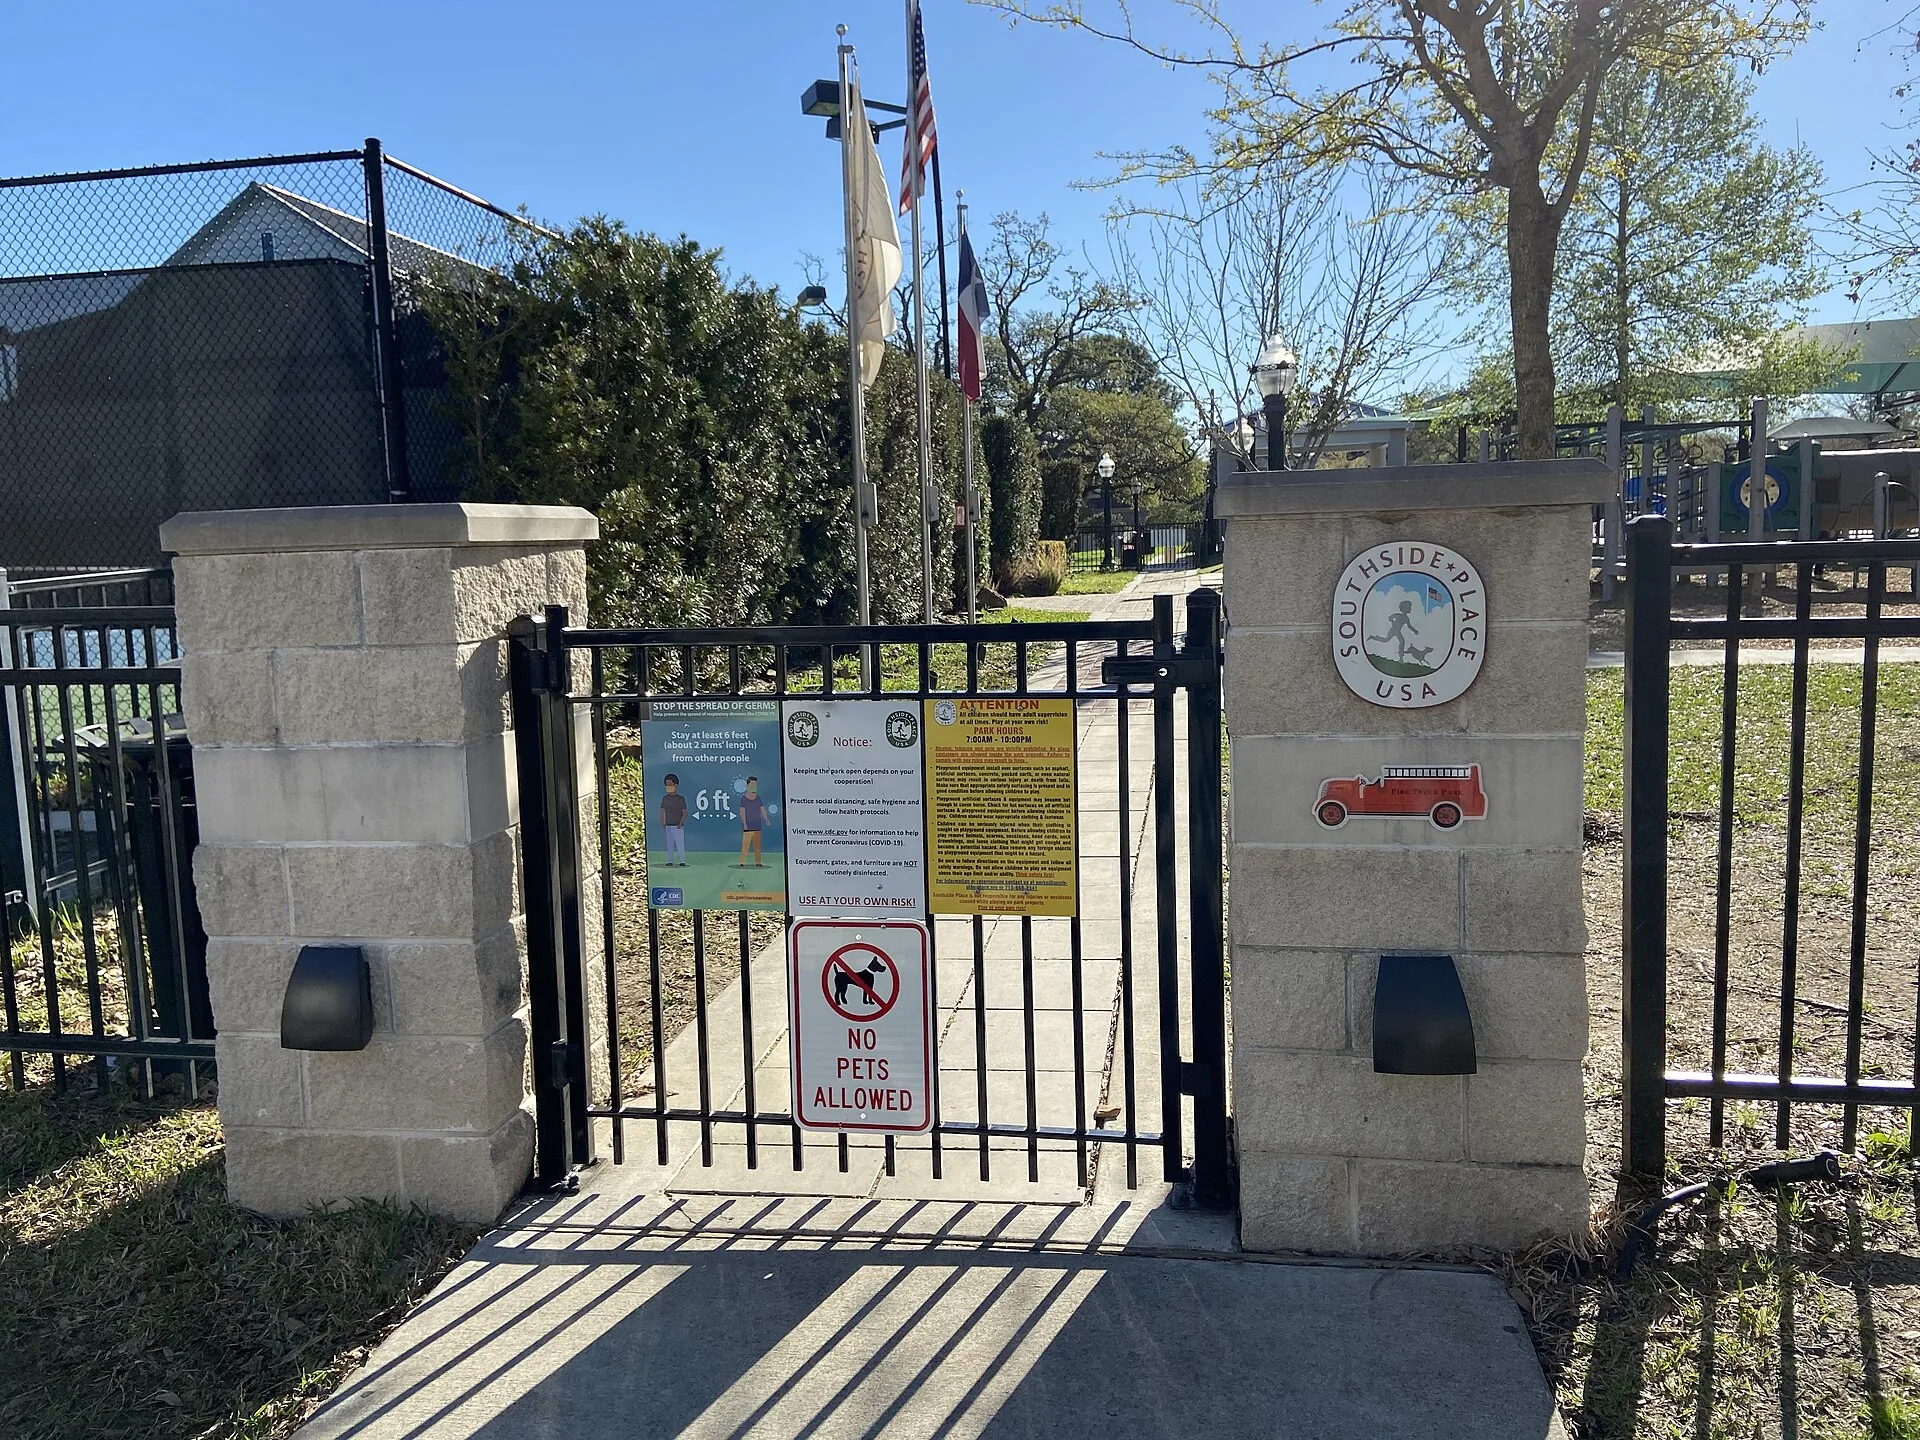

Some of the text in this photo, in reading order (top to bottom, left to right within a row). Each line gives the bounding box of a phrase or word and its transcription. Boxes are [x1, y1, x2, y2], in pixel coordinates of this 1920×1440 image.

[1339, 547, 1479, 661] SOUTHSIDE PLACE
[1376, 680, 1436, 701] USA
[653, 702, 676, 710] STOP
[677, 702, 693, 710] THE
[696, 702, 729, 710] SPREAD
[960, 700, 1039, 709] ATTENTION
[789, 712, 810, 736] SOUTHSIDE
[887, 712, 908, 736] SOUTHSIDE
[672, 731, 690, 740] Stay
[833, 737, 872, 746] Notice:
[726, 742, 756, 750] length)
[694, 754, 718, 762] other
[720, 754, 749, 763] people
[696, 790, 730, 810] 6 ft
[799, 896, 816, 904] USE
[819, 897, 831, 905] AT
[834, 897, 860, 905] YOUR
[892, 898, 916, 906] RISK!
[848, 1028, 876, 1050] NO
[837, 1058, 889, 1080] PETS
[814, 1087, 912, 1111] ALLOWED
